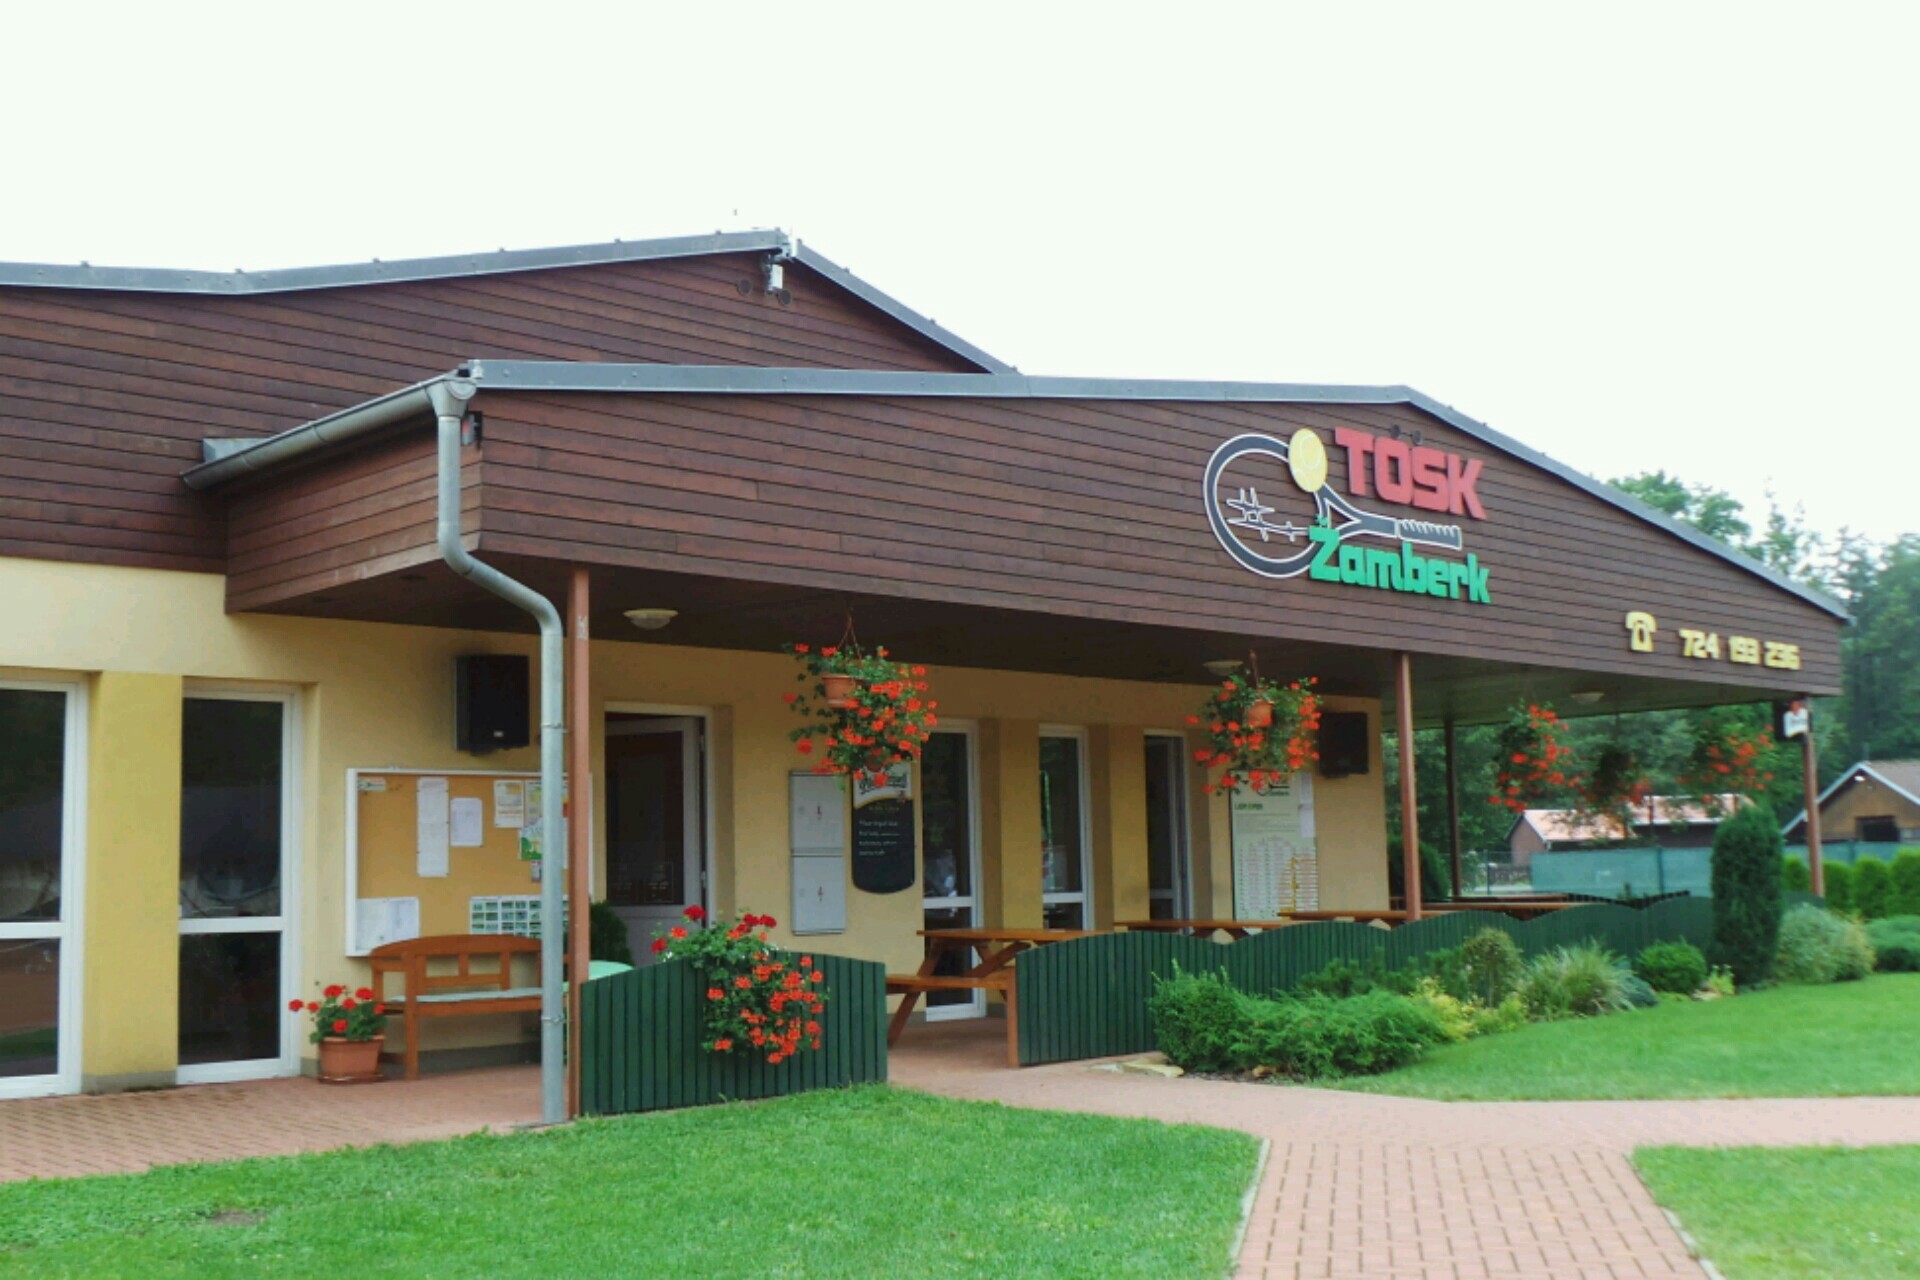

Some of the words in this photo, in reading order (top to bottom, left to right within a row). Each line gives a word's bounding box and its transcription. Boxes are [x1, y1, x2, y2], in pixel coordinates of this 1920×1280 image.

[1335, 427, 1487, 519] TOSK
[1308, 515, 1491, 603] Žamberk
[1679, 629, 1720, 660] 724
